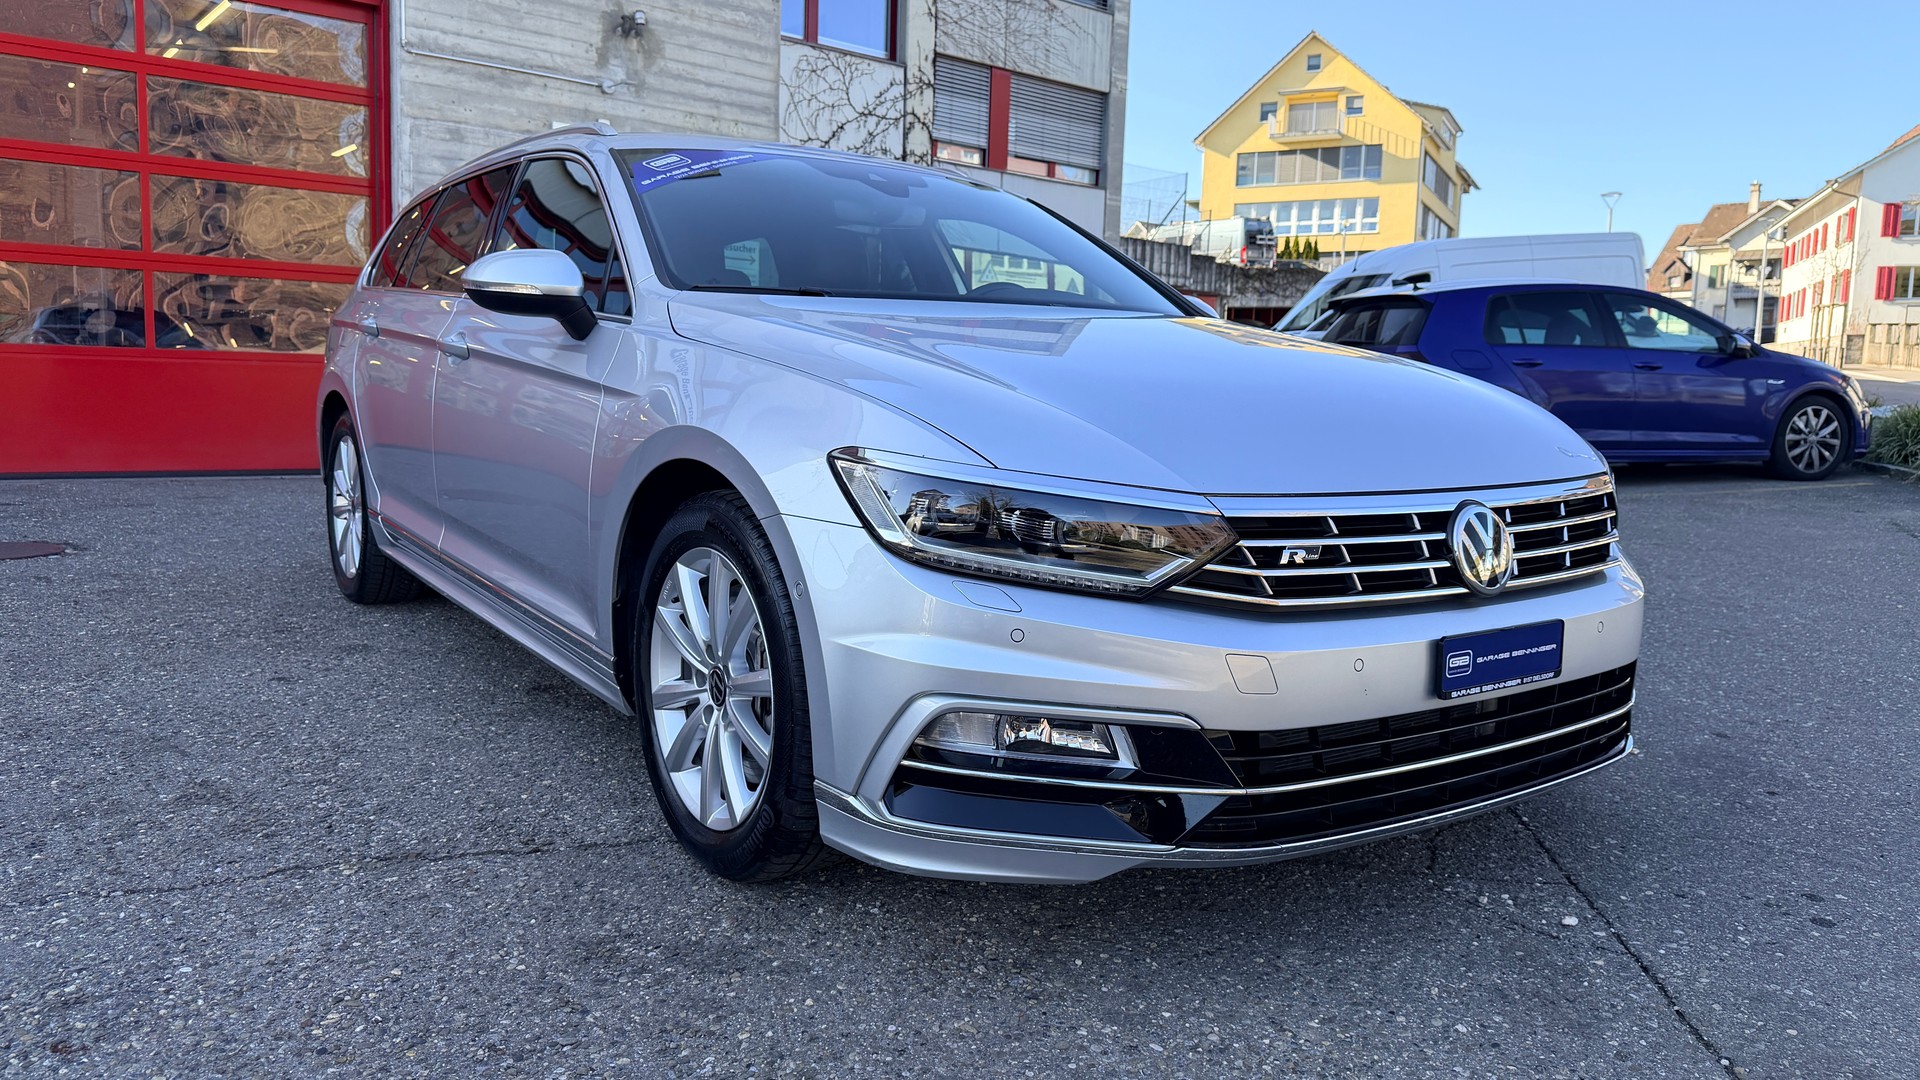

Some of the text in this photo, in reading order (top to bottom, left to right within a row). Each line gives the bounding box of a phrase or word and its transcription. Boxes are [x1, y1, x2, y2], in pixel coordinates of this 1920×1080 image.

[641, 167, 690, 185] GARAGE
[1449, 655, 1470, 668] GB
[1476, 643, 1557, 663] GARAGE BENNINGER
[1451, 687, 1481, 698] GARAGE
[1482, 678, 1522, 692] BENNINGER
[1533, 671, 1555, 681] DIELSDORF
[717, 804, 775, 869] Continenta
